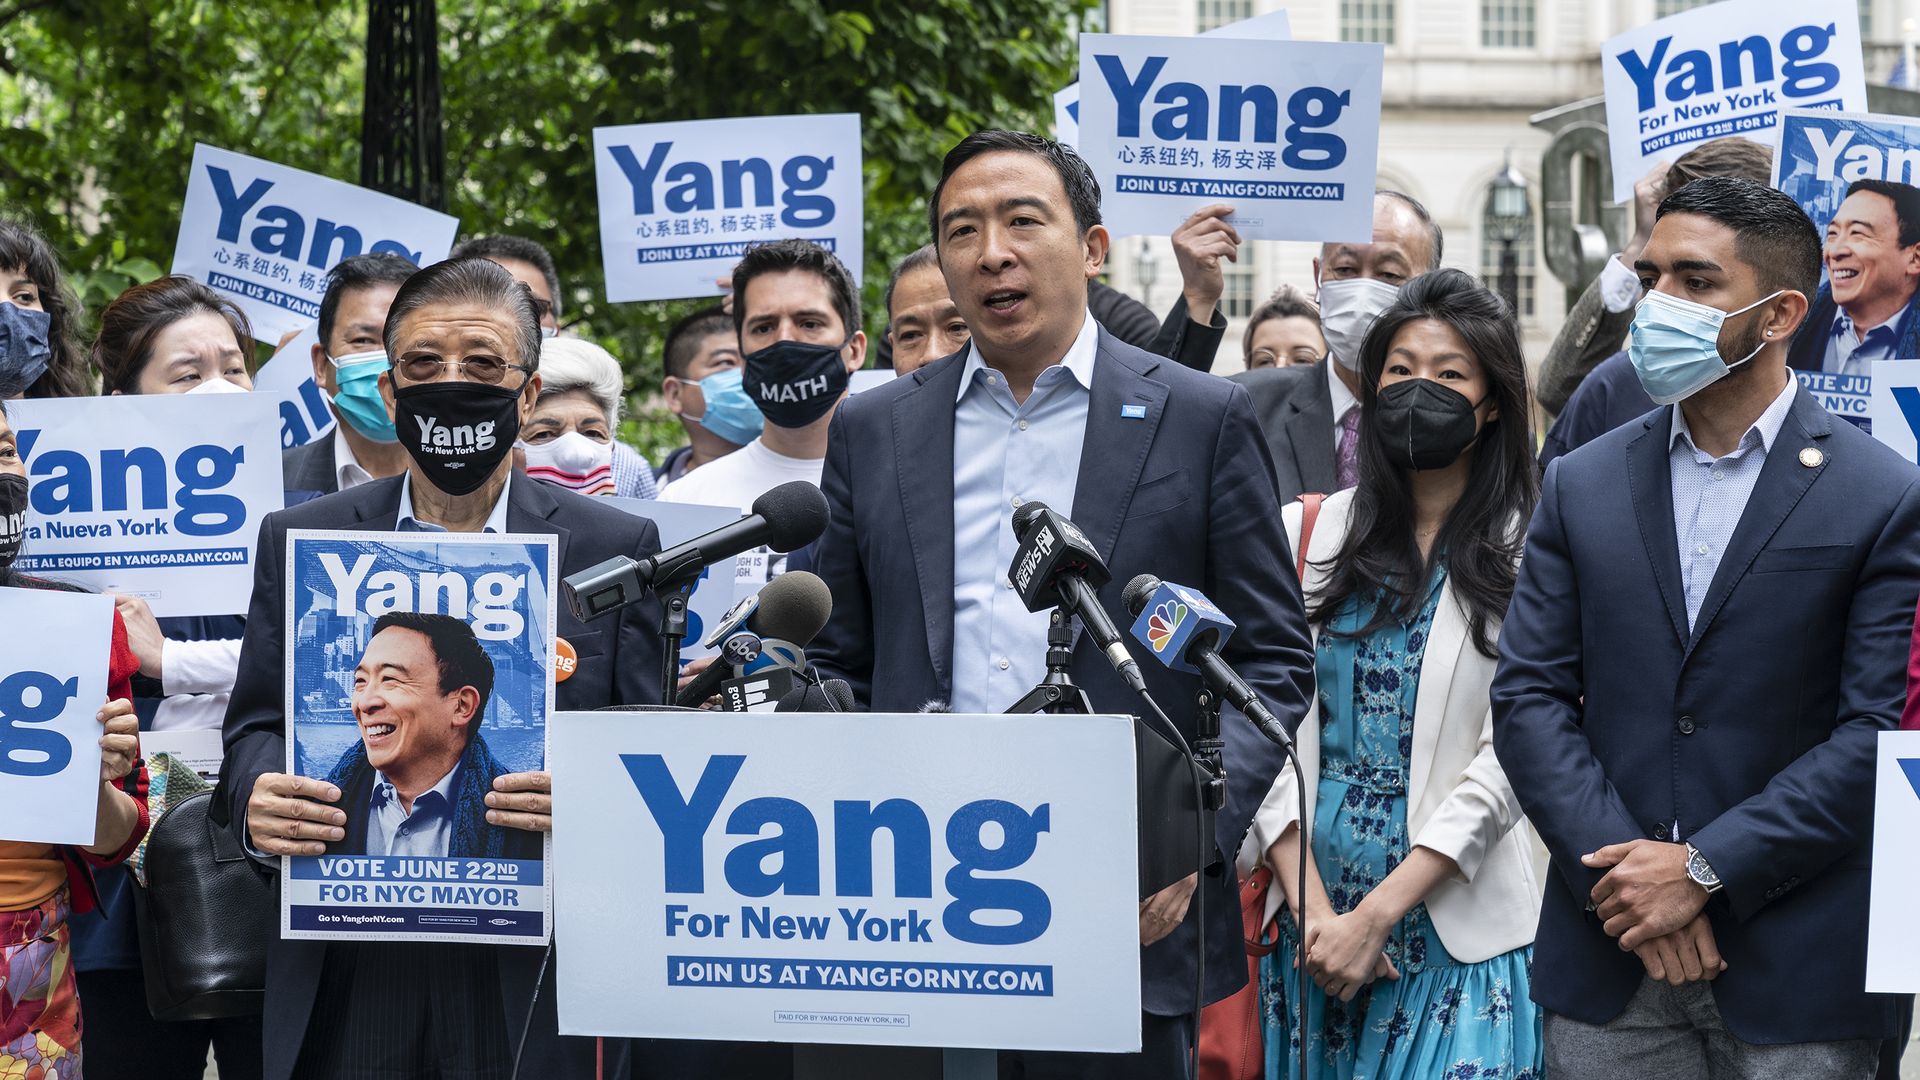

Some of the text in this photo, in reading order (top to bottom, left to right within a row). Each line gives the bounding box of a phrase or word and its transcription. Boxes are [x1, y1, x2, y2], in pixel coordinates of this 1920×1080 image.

[1616, 22, 1840, 113] Yang
[1093, 54, 1350, 170] Yang
[1639, 90, 1777, 134] For New York
[1643, 137, 1671, 152] VOTE
[1674, 129, 1703, 146] JUNE
[1736, 117, 1760, 131] FOR
[607, 141, 836, 228] Yang
[1120, 178, 1339, 198] JOIN US AT YANGFORNY.COM
[641, 248, 672, 262] JOIN
[675, 247, 693, 260] US
[695, 245, 712, 258] AT
[211, 274, 320, 317] JOIN US AT YANG
[760, 375, 828, 403] MATH
[1796, 373, 1837, 391] OTE
[1825, 396, 1867, 413] NYC
[413, 414, 496, 451] Yang
[421, 445, 475, 455] For New York
[46, 521, 112, 539] Nueva
[116, 517, 168, 536] York
[41, 559, 56, 569] AL
[58, 557, 101, 568] EQUIPO
[104, 555, 121, 566] EN
[124, 551, 244, 565] YANGPARANY.COM
[753, 557, 762, 567] IS
[1016, 546, 1042, 594] NEWS
[318, 553, 526, 641] Yang
[728, 641, 758, 662] abc
[619, 753, 1052, 945] Yang
[318, 858, 385, 878] VOTE
[391, 859, 459, 879] JUNE
[319, 884, 520, 907] FOR NYC MAYOR
[318, 914, 331, 922] Go
[341, 914, 405, 924] YangforNY.com
[665, 904, 934, 943] For New York
[676, 962, 1044, 991] JOIN US AT YANGFORNY.COM
[871, 1016, 892, 1024] YORK,
